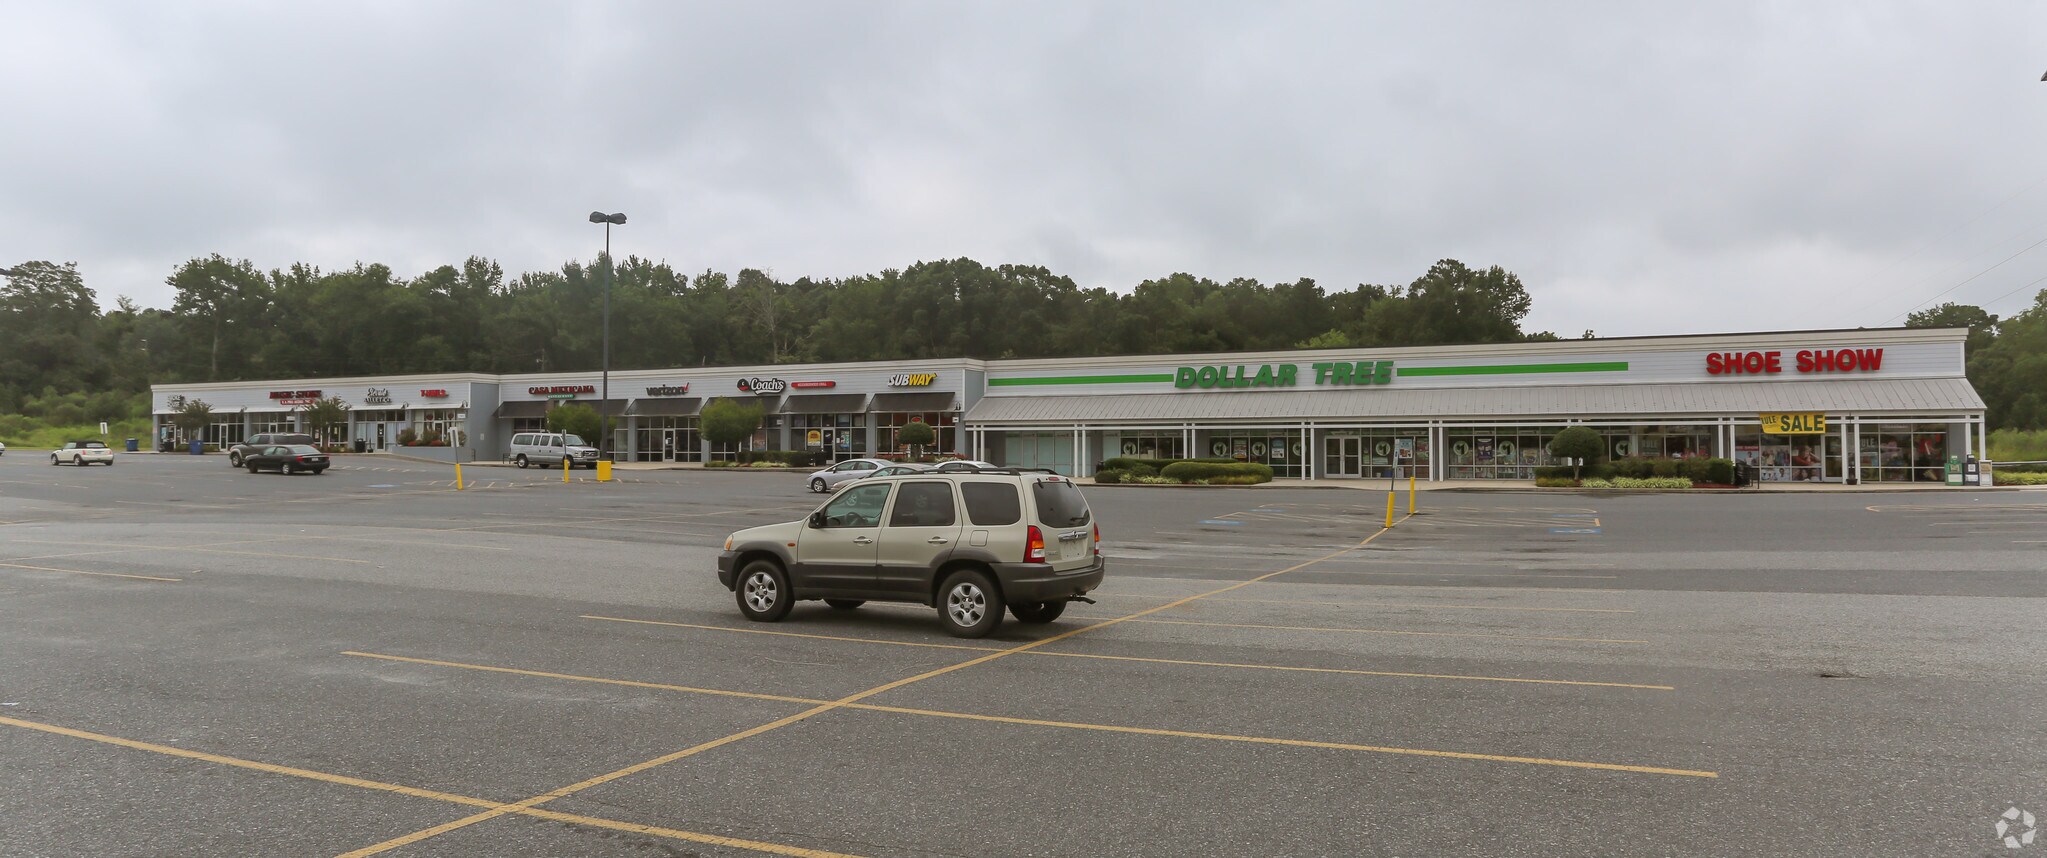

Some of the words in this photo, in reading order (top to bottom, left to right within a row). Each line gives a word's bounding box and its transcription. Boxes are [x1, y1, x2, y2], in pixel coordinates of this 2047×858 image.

[1706, 351, 1782, 375] SHOE
[1795, 348, 1884, 373] SHOW
[888, 373, 936, 386] SUBWAY
[1174, 363, 1298, 389] DOLLAR
[1311, 361, 1394, 385] TREE
[528, 386, 550, 395] CASA
[550, 385, 595, 394] MEXICANA
[645, 383, 685, 396] verizon
[750, 378, 784, 391] Coach's
[1780, 414, 1824, 431] SALE
